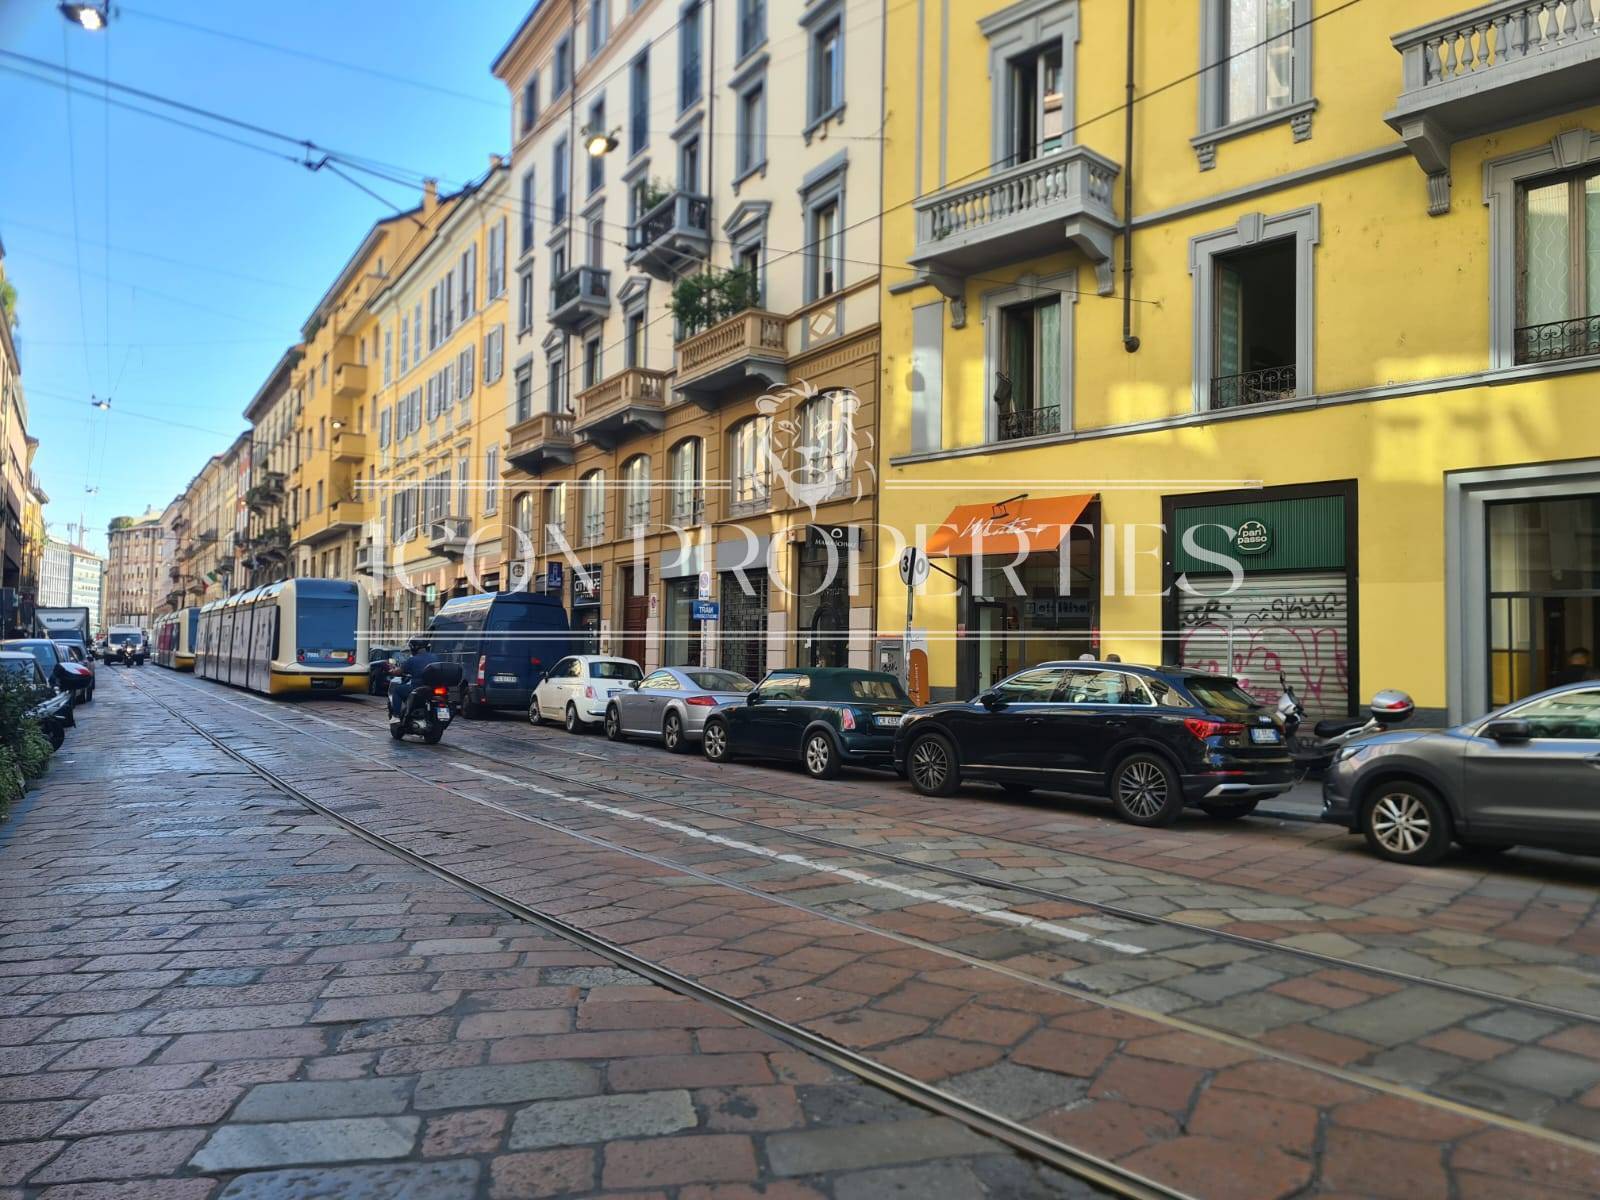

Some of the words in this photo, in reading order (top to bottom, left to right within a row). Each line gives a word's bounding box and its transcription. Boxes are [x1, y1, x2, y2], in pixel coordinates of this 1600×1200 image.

[1242, 528, 1261, 538] pari
[1237, 536, 1267, 545] passo
[902, 555, 926, 575] 30
